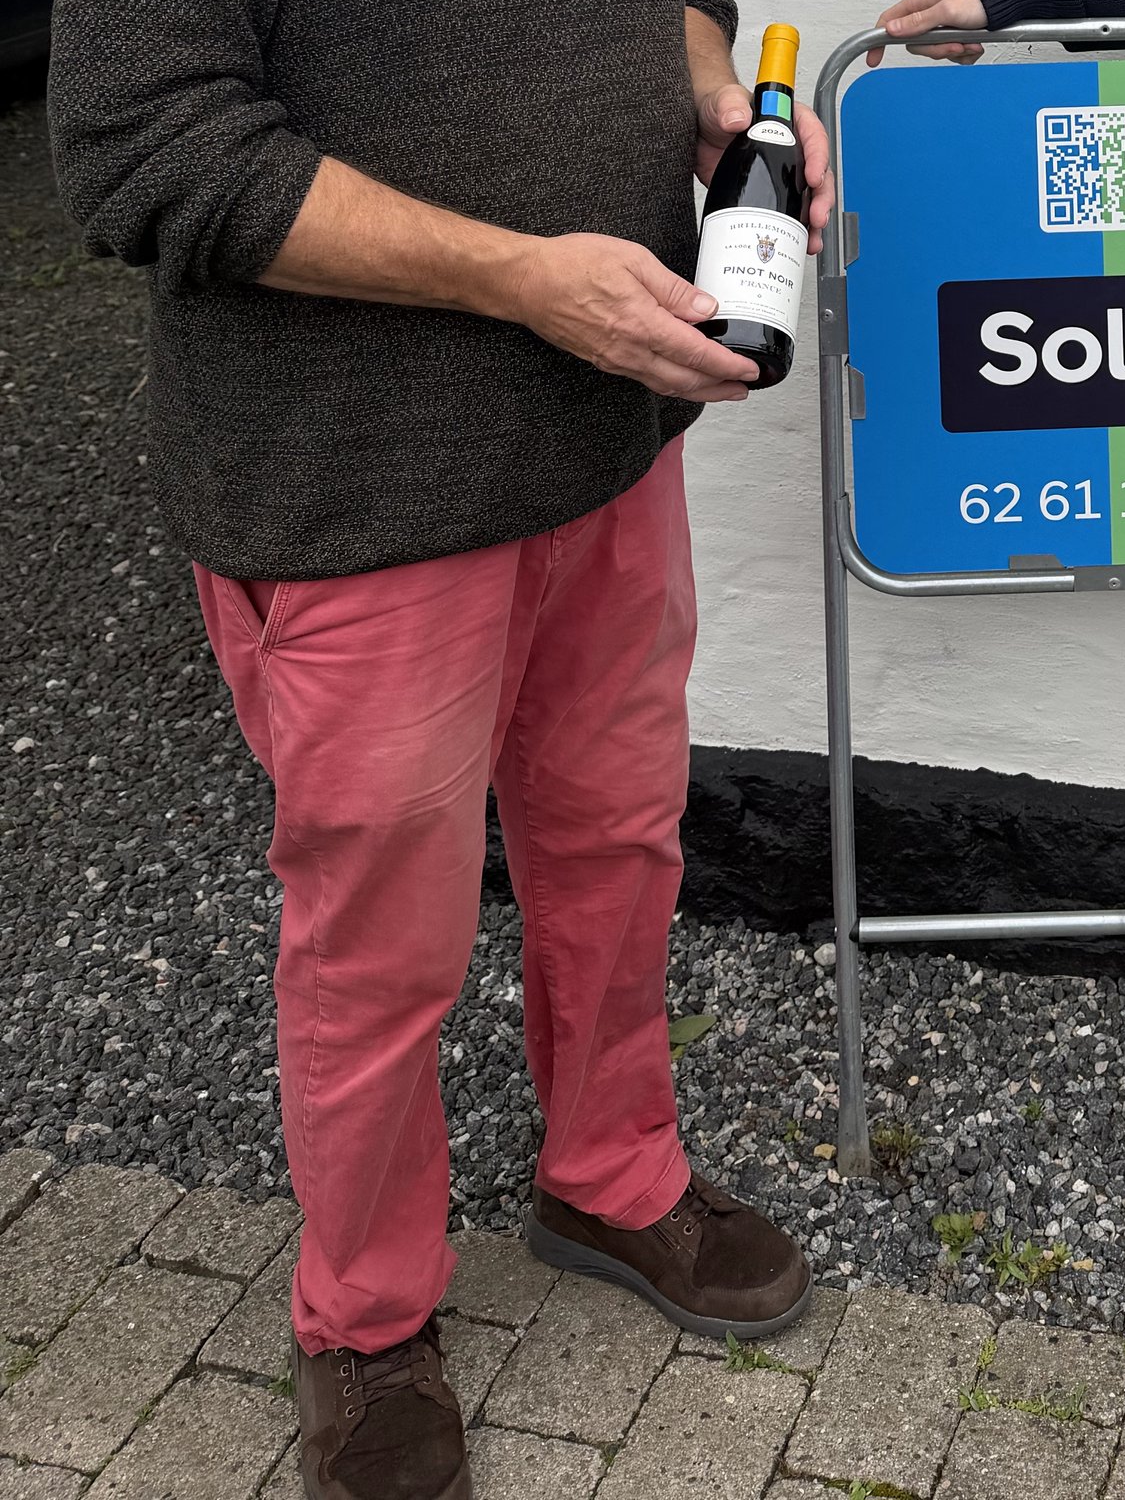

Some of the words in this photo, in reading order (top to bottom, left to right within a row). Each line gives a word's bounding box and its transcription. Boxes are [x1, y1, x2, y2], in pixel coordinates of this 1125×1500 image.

[761, 128, 785, 137] 2024
[723, 266, 765, 277] PINOT
[768, 271, 795, 290] NOIR
[740, 279, 782, 295] FRANCE
[959, 482, 1023, 524] 62
[1039, 479, 1101, 520] 61
